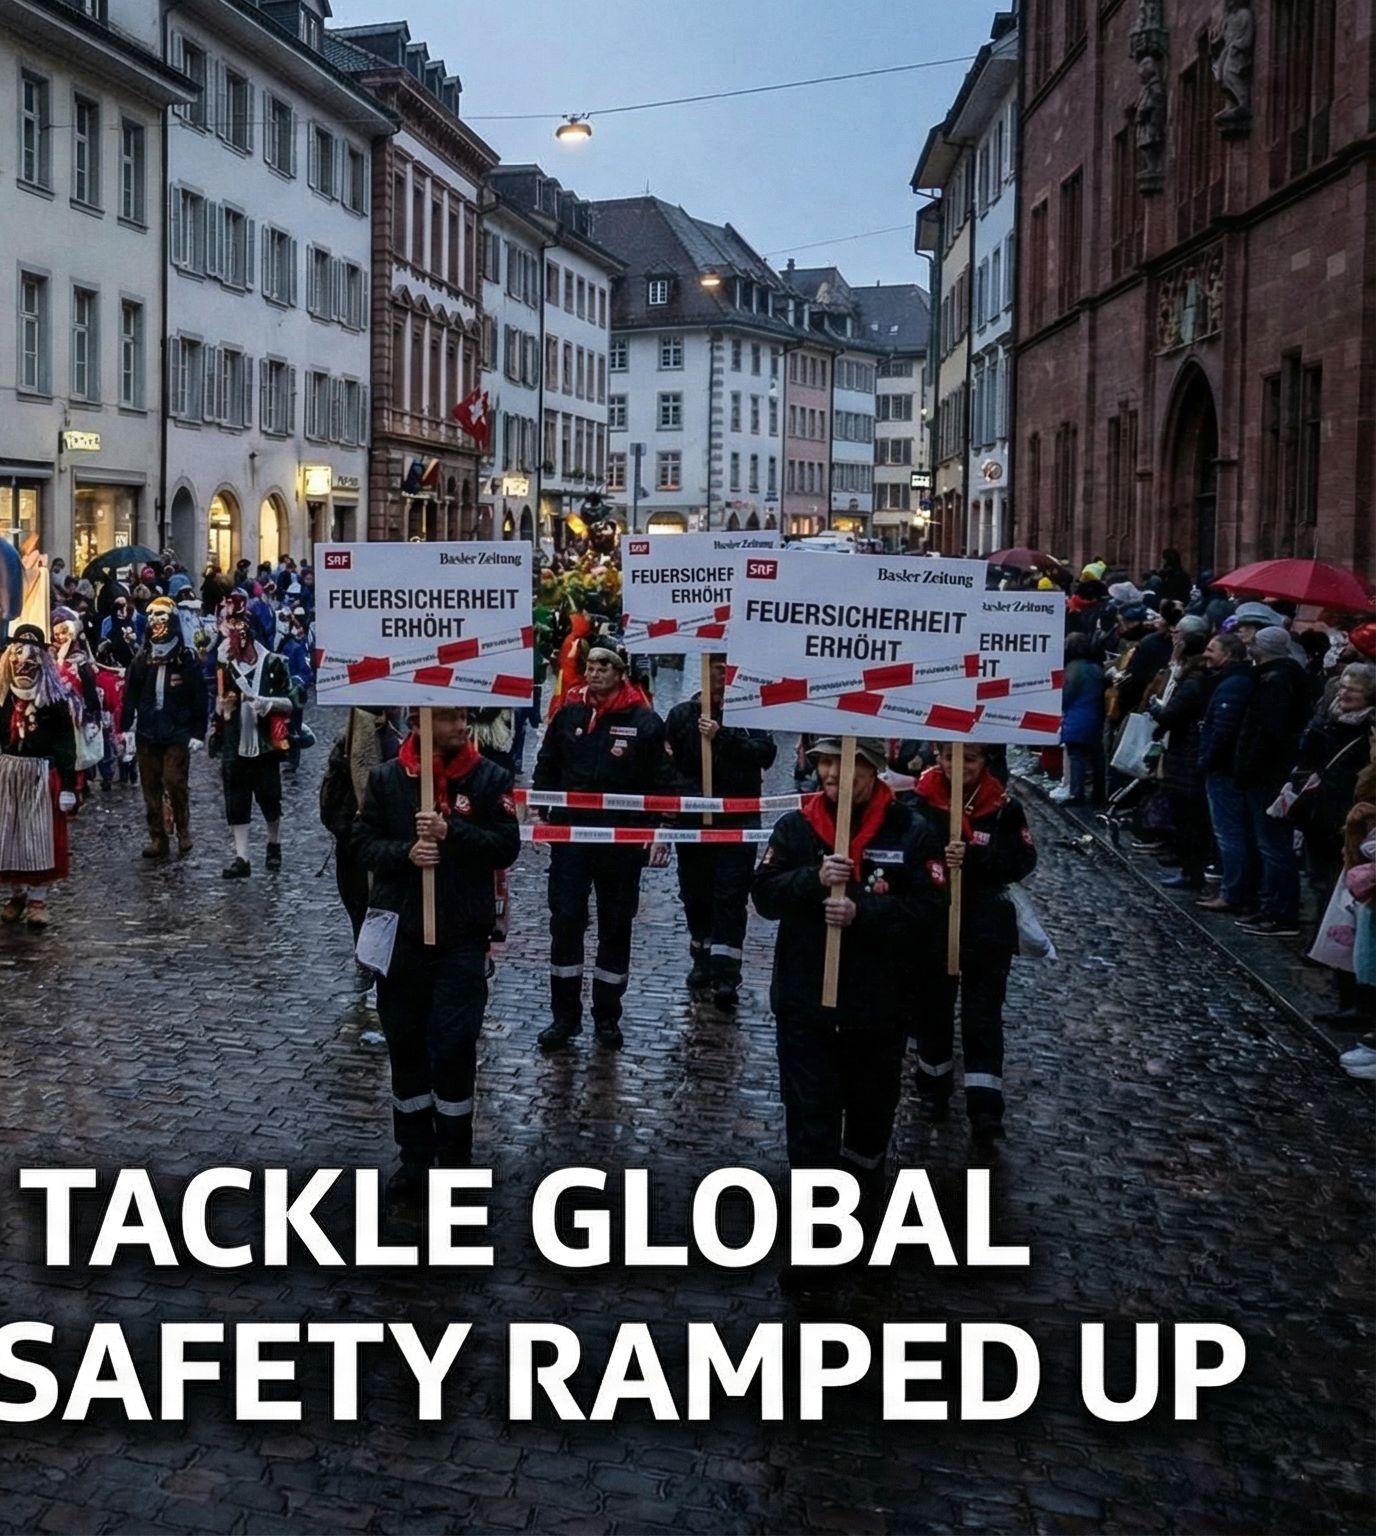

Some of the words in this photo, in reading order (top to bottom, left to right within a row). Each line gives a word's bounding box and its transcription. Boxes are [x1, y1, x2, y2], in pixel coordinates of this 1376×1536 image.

[478, 552, 522, 567] Zeitung
[749, 563, 775, 576] SRF
[878, 567, 922, 583] Basler
[922, 570, 974, 588] Zeitung
[329, 588, 520, 610] FEUERSICHERHEIT
[672, 585, 733, 604] ERHÖHT
[381, 612, 465, 638] ERHÖHT
[746, 599, 968, 635] FEUERSICHERHEIT
[805, 633, 902, 662] ERHÖHT
